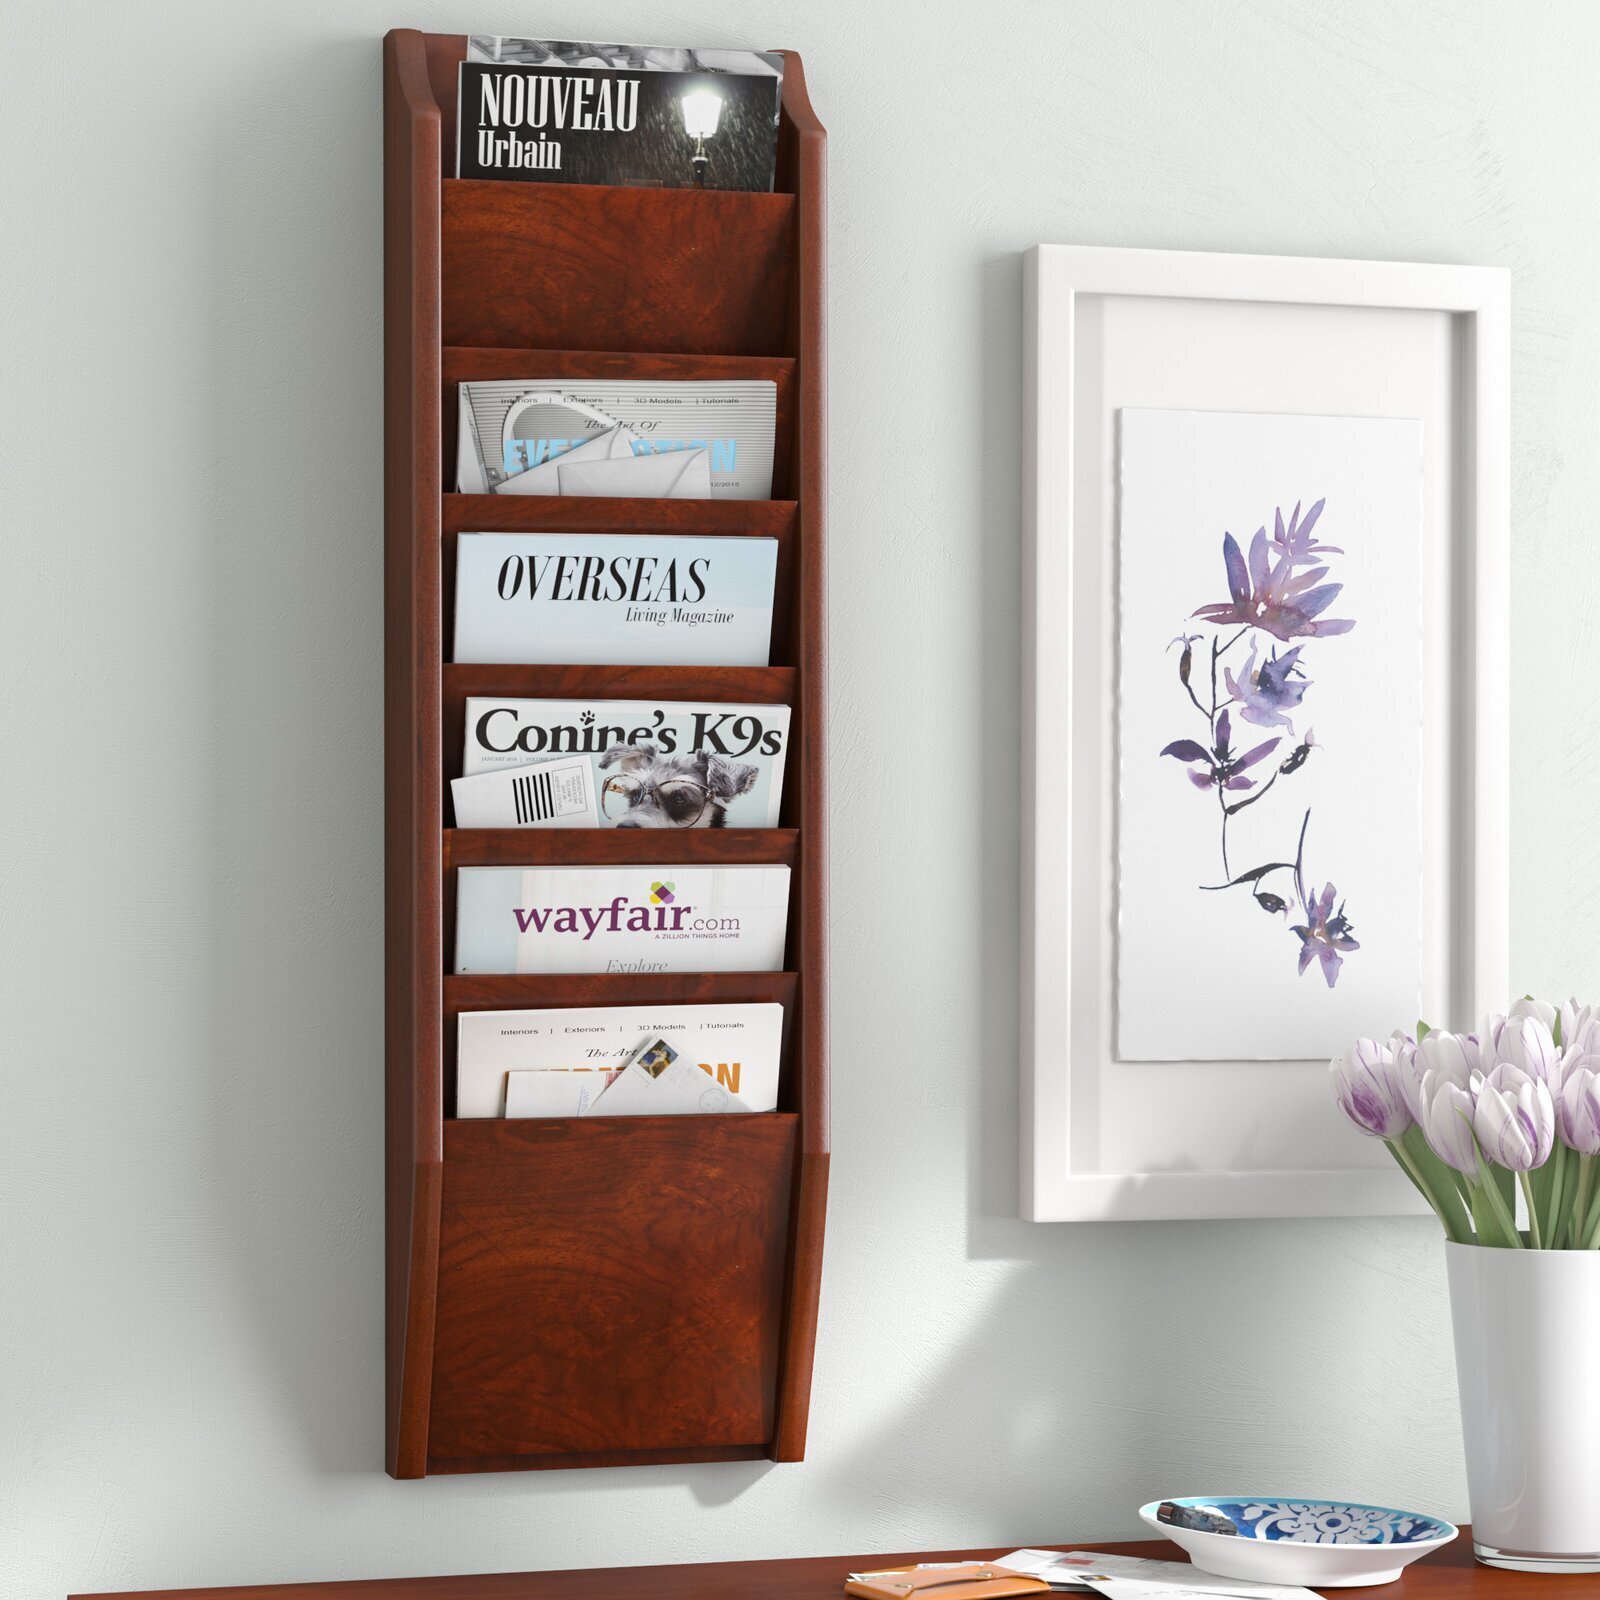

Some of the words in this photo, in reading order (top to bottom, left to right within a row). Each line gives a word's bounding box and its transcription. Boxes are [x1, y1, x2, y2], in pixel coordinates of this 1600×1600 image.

[478, 73, 641, 132] NOUVEAU
[477, 130, 562, 170] Urbain
[501, 397, 538, 405] Interiors
[563, 396, 603, 404] Exteriors
[634, 397, 647, 405] 3D
[649, 397, 682, 405] Models
[702, 397, 740, 405] Tutorials
[584, 419, 607, 429] The
[611, 420, 635, 430] Art
[640, 420, 663, 432] Of
[497, 554, 711, 604] OVERSEAS
[625, 607, 667, 627] Living
[670, 607, 734, 627] Magazine
[687, 712, 782, 758] K9s
[606, 958, 669, 973] Explore
[564, 1026, 606, 1034] Exteriors
[706, 1022, 744, 1030] Tutorials
[585, 1048, 609, 1058] The
[613, 1048, 638, 1057] Art
